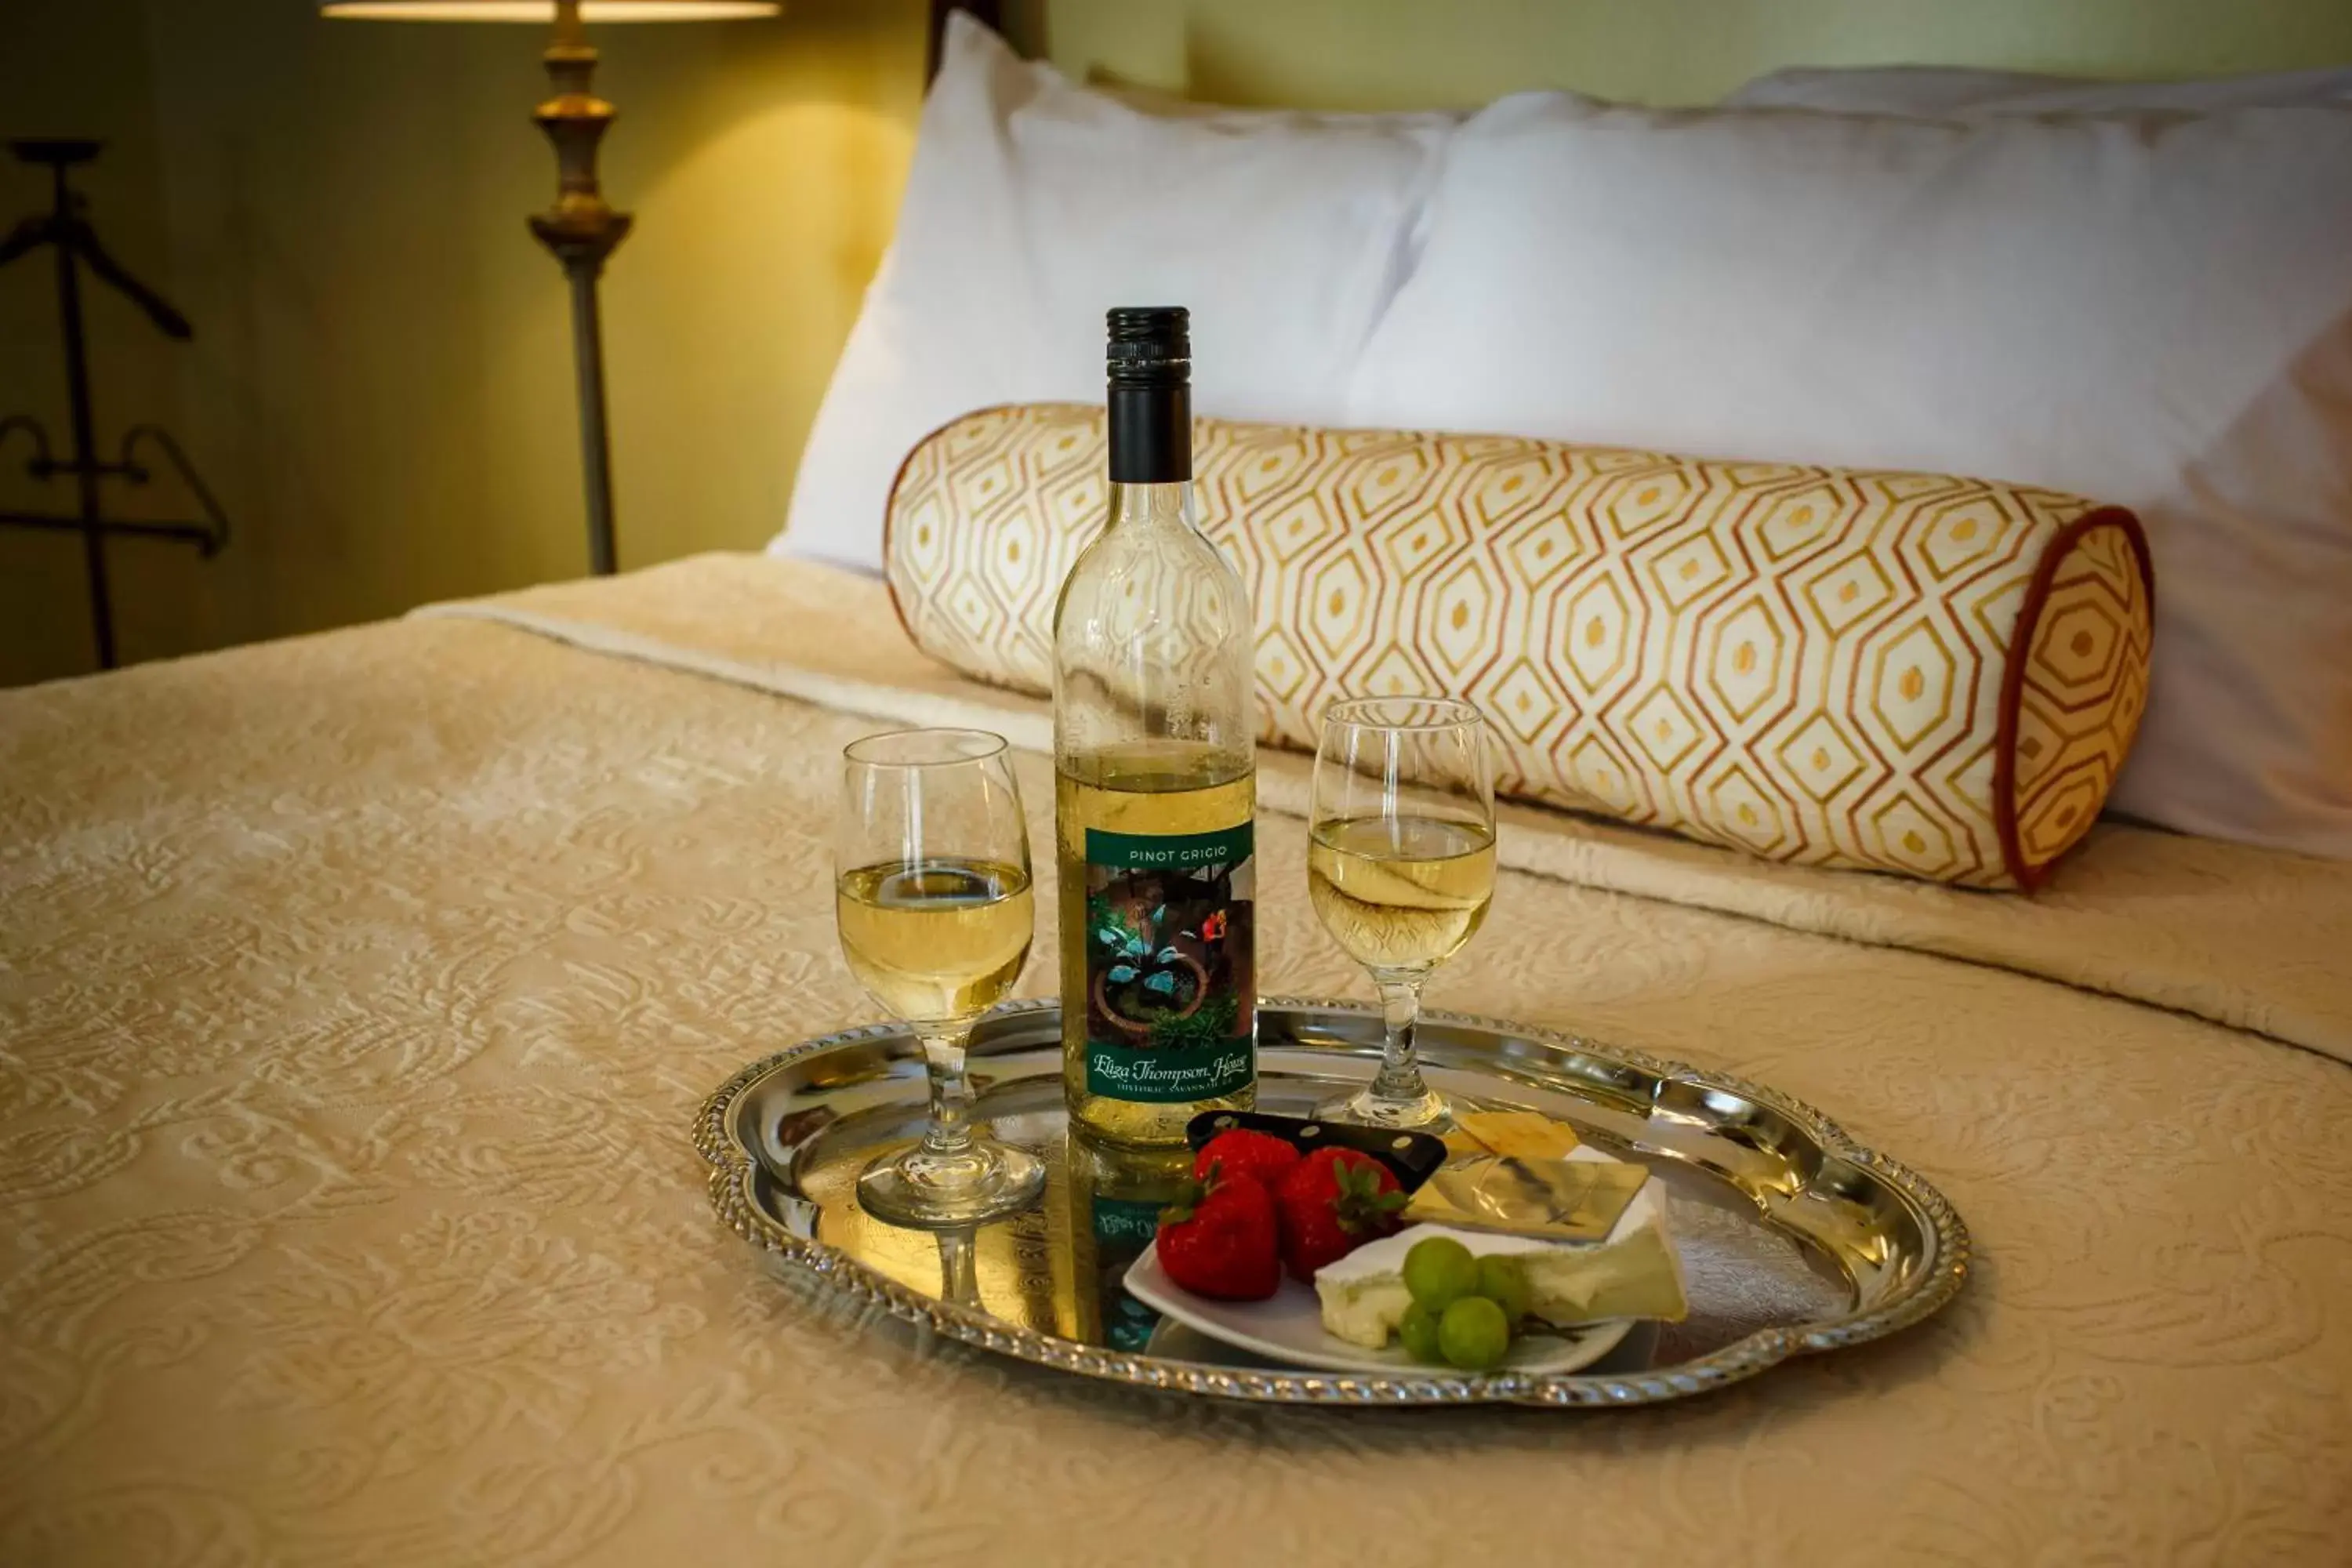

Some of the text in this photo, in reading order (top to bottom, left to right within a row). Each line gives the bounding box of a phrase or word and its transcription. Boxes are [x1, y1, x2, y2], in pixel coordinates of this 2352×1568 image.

[1130, 846, 1227, 862] PINOT GRIGIO
[1094, 1054, 1129, 1082] Eliza
[1132, 1058, 1210, 1091] Thompson
